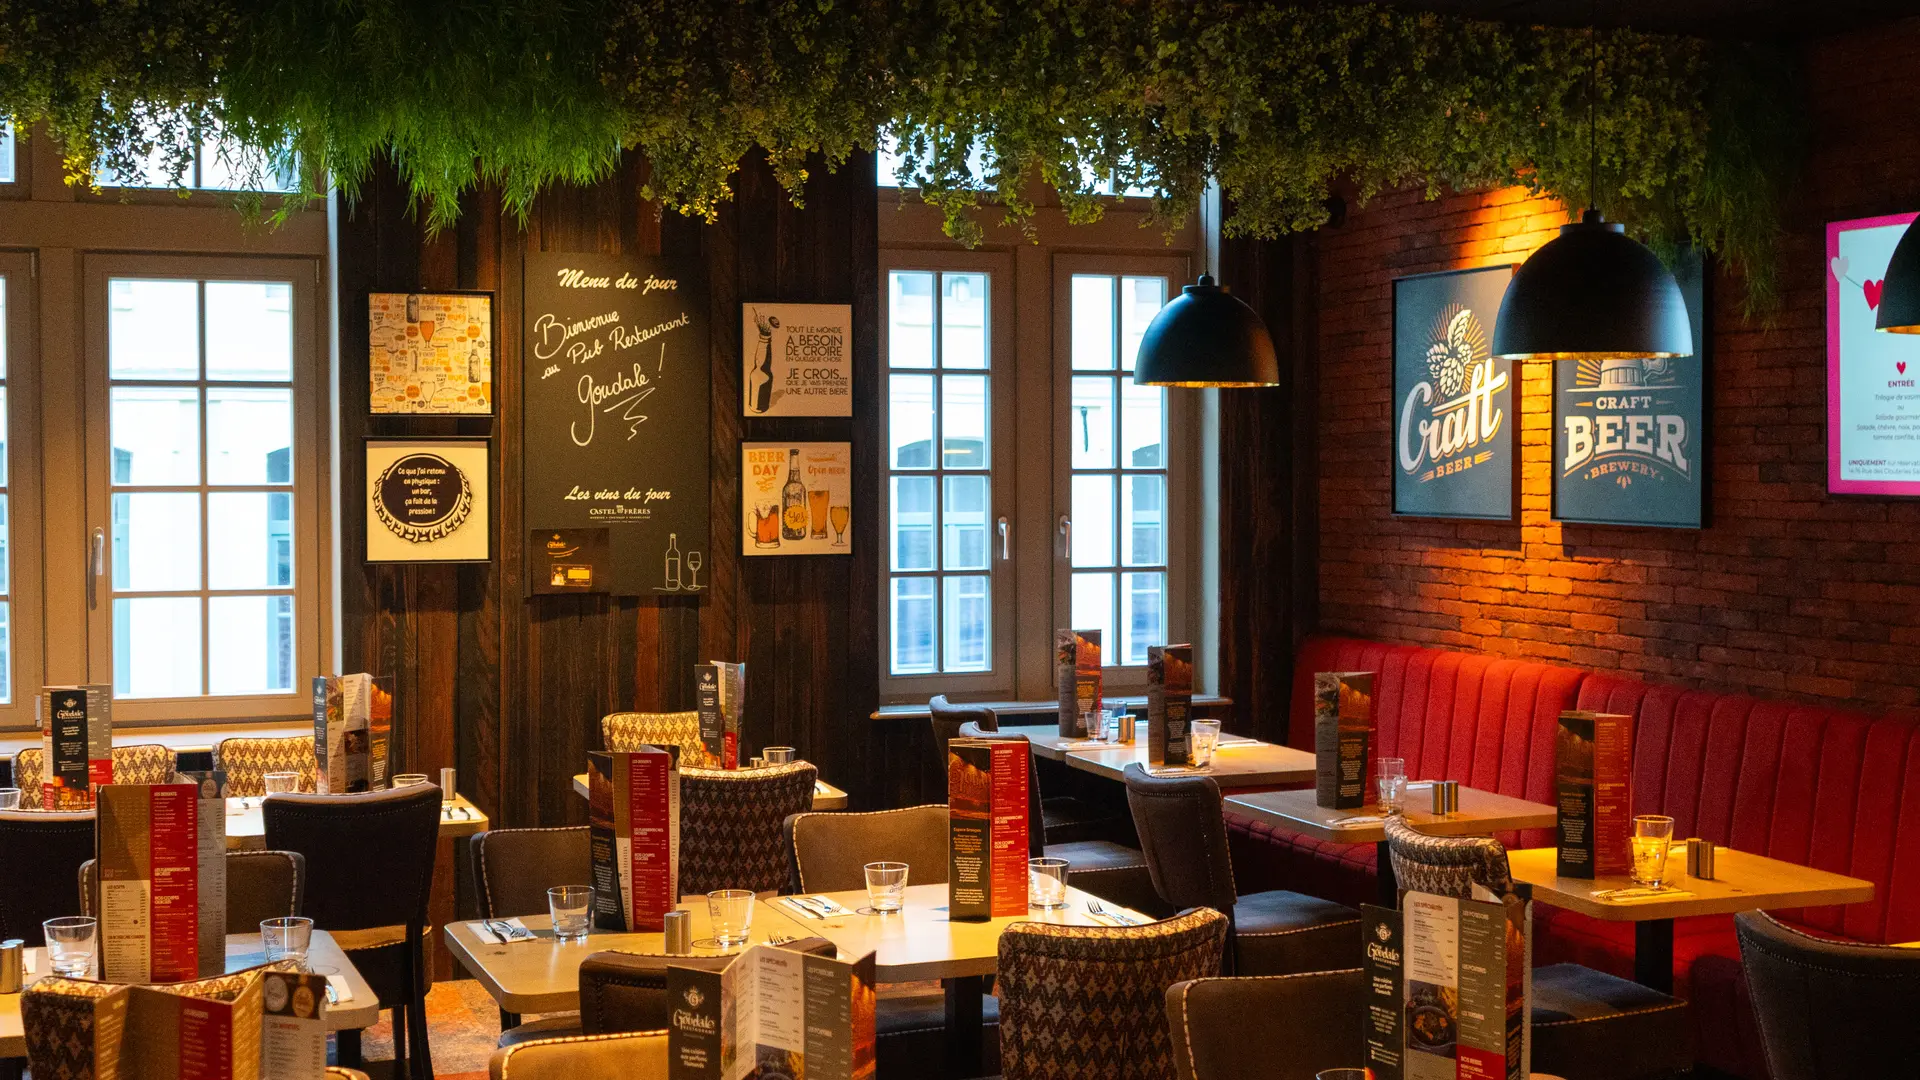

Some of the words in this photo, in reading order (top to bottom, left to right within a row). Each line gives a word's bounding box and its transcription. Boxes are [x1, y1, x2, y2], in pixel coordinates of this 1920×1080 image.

[557, 268, 610, 288] Menu
[615, 272, 638, 289] du
[642, 274, 678, 295] jour
[534, 311, 620, 359] Bienvenue
[816, 326, 843, 334] MONDE
[541, 364, 561, 380] au
[566, 338, 604, 364] Pub
[608, 312, 690, 351] Restaurant
[786, 335, 794, 346] A
[799, 334, 843, 346] BESOIN
[786, 346, 799, 356] DE
[802, 346, 843, 356] CROIRE
[786, 368, 799, 379] JE
[803, 368, 848, 380] CROIS...
[1888, 378, 1915, 388] ENTRÉE
[1596, 396, 1652, 410] CRAFT
[1399, 357, 1508, 473] Craft
[1564, 415, 1688, 471] BEER
[748, 451, 785, 463] BEER
[753, 464, 780, 476] DAY
[1436, 455, 1473, 478] BEER
[1590, 460, 1659, 479] BREWERY
[411, 478, 437, 486] physique
[564, 485, 591, 501] Les
[593, 489, 620, 500] vins
[623, 486, 642, 500] du
[644, 488, 671, 504] jour
[589, 507, 615, 515] CASTEL
[673, 1009, 715, 1030] Goudale
